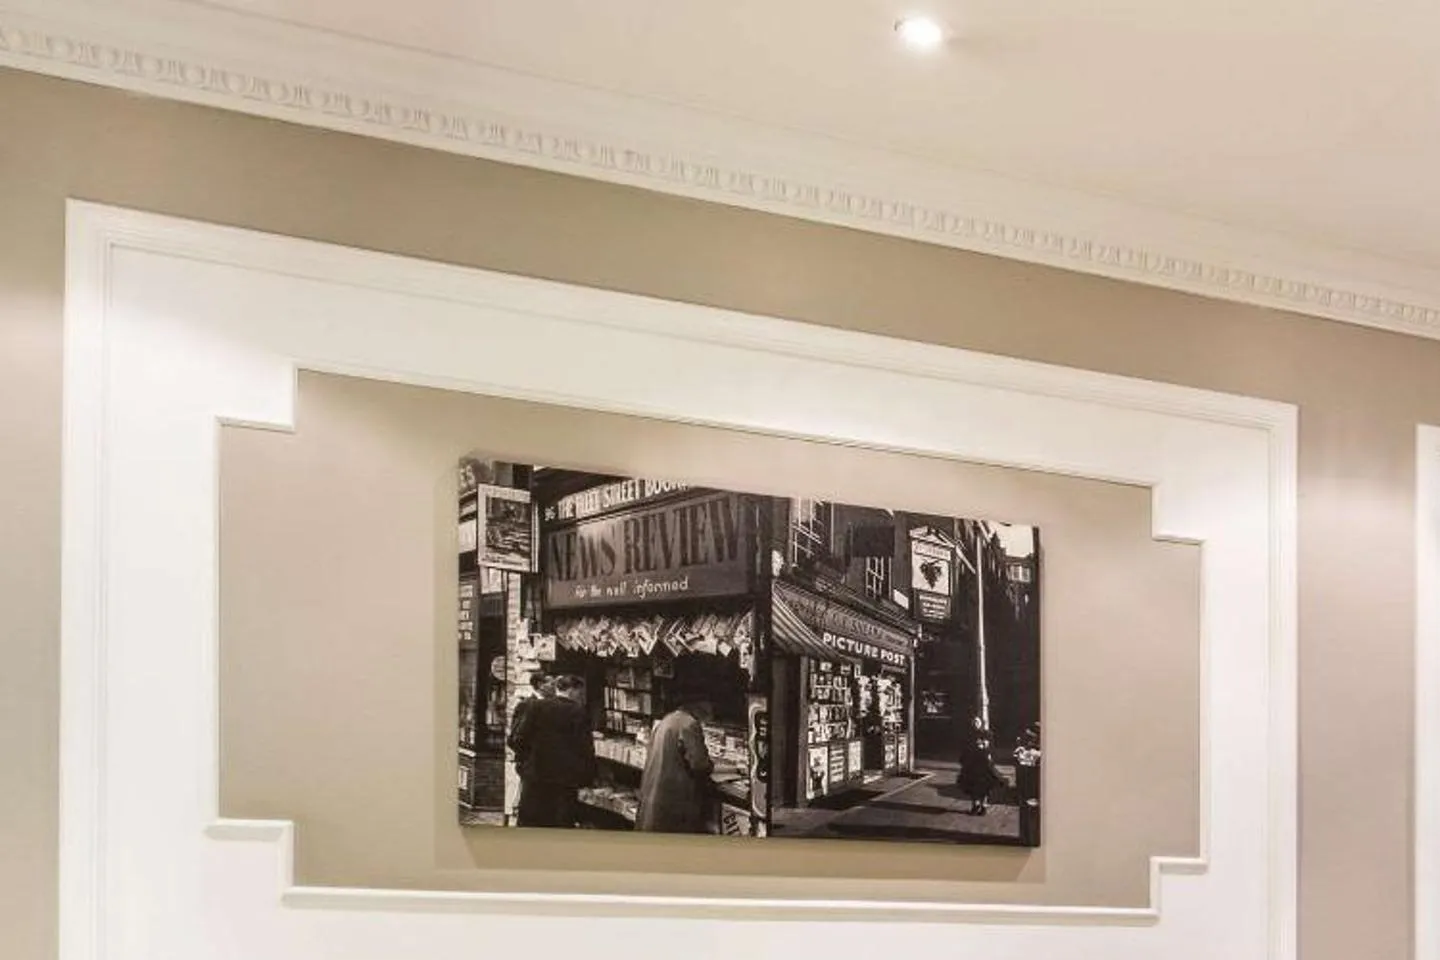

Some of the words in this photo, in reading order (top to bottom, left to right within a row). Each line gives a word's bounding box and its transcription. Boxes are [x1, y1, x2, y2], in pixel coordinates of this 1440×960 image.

[622, 497, 740, 575] REVIEW
[633, 576, 689, 600] informed
[822, 631, 879, 659] PICTURE
[880, 648, 906, 666] POST
